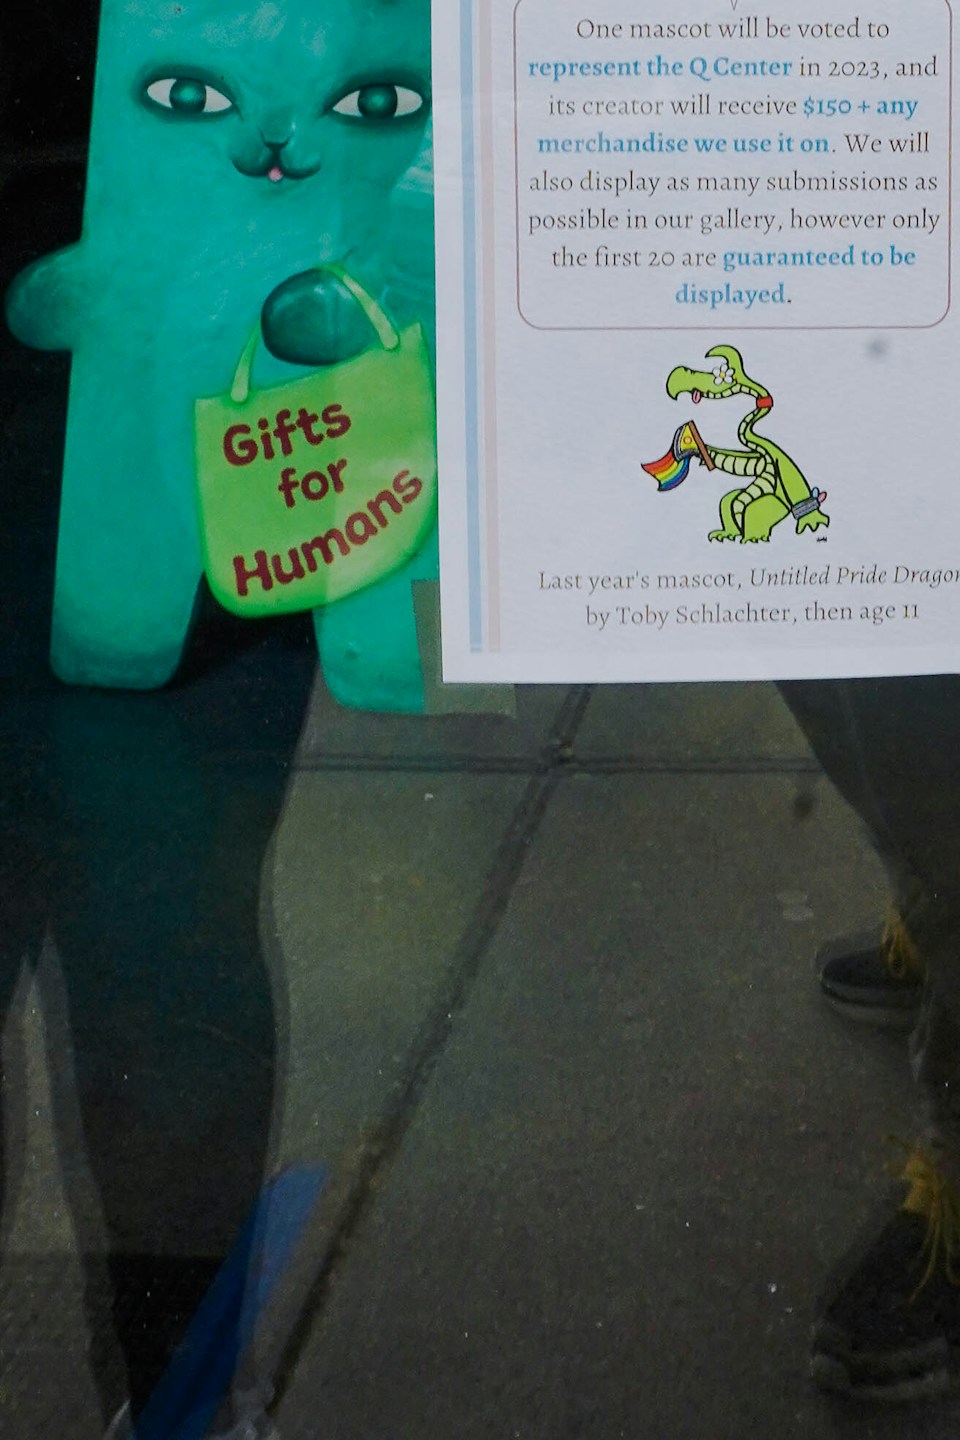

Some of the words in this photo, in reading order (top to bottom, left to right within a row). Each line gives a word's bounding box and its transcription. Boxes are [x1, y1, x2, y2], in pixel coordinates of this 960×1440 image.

[576, 18, 623, 39] One
[629, 21, 712, 39] mascot
[717, 15, 759, 39] will
[765, 15, 791, 39] be
[797, 15, 862, 39] voted
[867, 21, 890, 39] to
[528, 59, 642, 82] represent
[646, 53, 684, 77] the
[688, 56, 712, 82] Q
[713, 56, 793, 77] Center
[799, 55, 821, 77] in
[828, 60, 888, 80] 2023,
[895, 54, 939, 78] and
[549, 94, 576, 116] its
[582, 99, 664, 116] creator
[670, 93, 710, 116] will
[718, 94, 797, 116] receive
[803, 95, 852, 119] $150
[876, 99, 919, 121] any
[537, 130, 689, 154] merchandise
[693, 137, 728, 154] we
[732, 138, 772, 153] use
[777, 132, 795, 154] it
[799, 137, 836, 154] on.
[843, 133, 882, 153] We
[888, 130, 930, 154] will
[529, 169, 574, 192] also
[579, 169, 661, 198] display
[666, 176, 690, 192] as
[696, 176, 761, 198] many
[766, 169, 908, 192] submissions
[914, 176, 938, 191] as
[528, 207, 619, 236] possible
[626, 208, 648, 230] in
[654, 214, 694, 229] our
[700, 207, 783, 236] gallery,
[790, 207, 887, 229] however
[892, 206, 941, 235] only
[551, 245, 588, 268] the
[594, 244, 642, 268] first
[647, 251, 675, 267] 20
[681, 252, 717, 267] are
[722, 243, 856, 273] guaranteed
[860, 249, 884, 267] to
[889, 243, 917, 267] be
[675, 281, 792, 310] displayed.
[223, 404, 352, 466] Gifts
[279, 459, 348, 508] for
[232, 469, 423, 597] Humans
[539, 570, 581, 590] Last
[588, 570, 650, 595] year's
[657, 572, 742, 591] mascot,
[750, 565, 831, 587] Untitled
[836, 564, 887, 585] Pride
[586, 604, 611, 632] by
[615, 603, 670, 631] Toby
[676, 601, 797, 625] Schlachter,
[804, 600, 852, 622] then
[859, 605, 896, 625] age
[902, 603, 919, 619] 11
